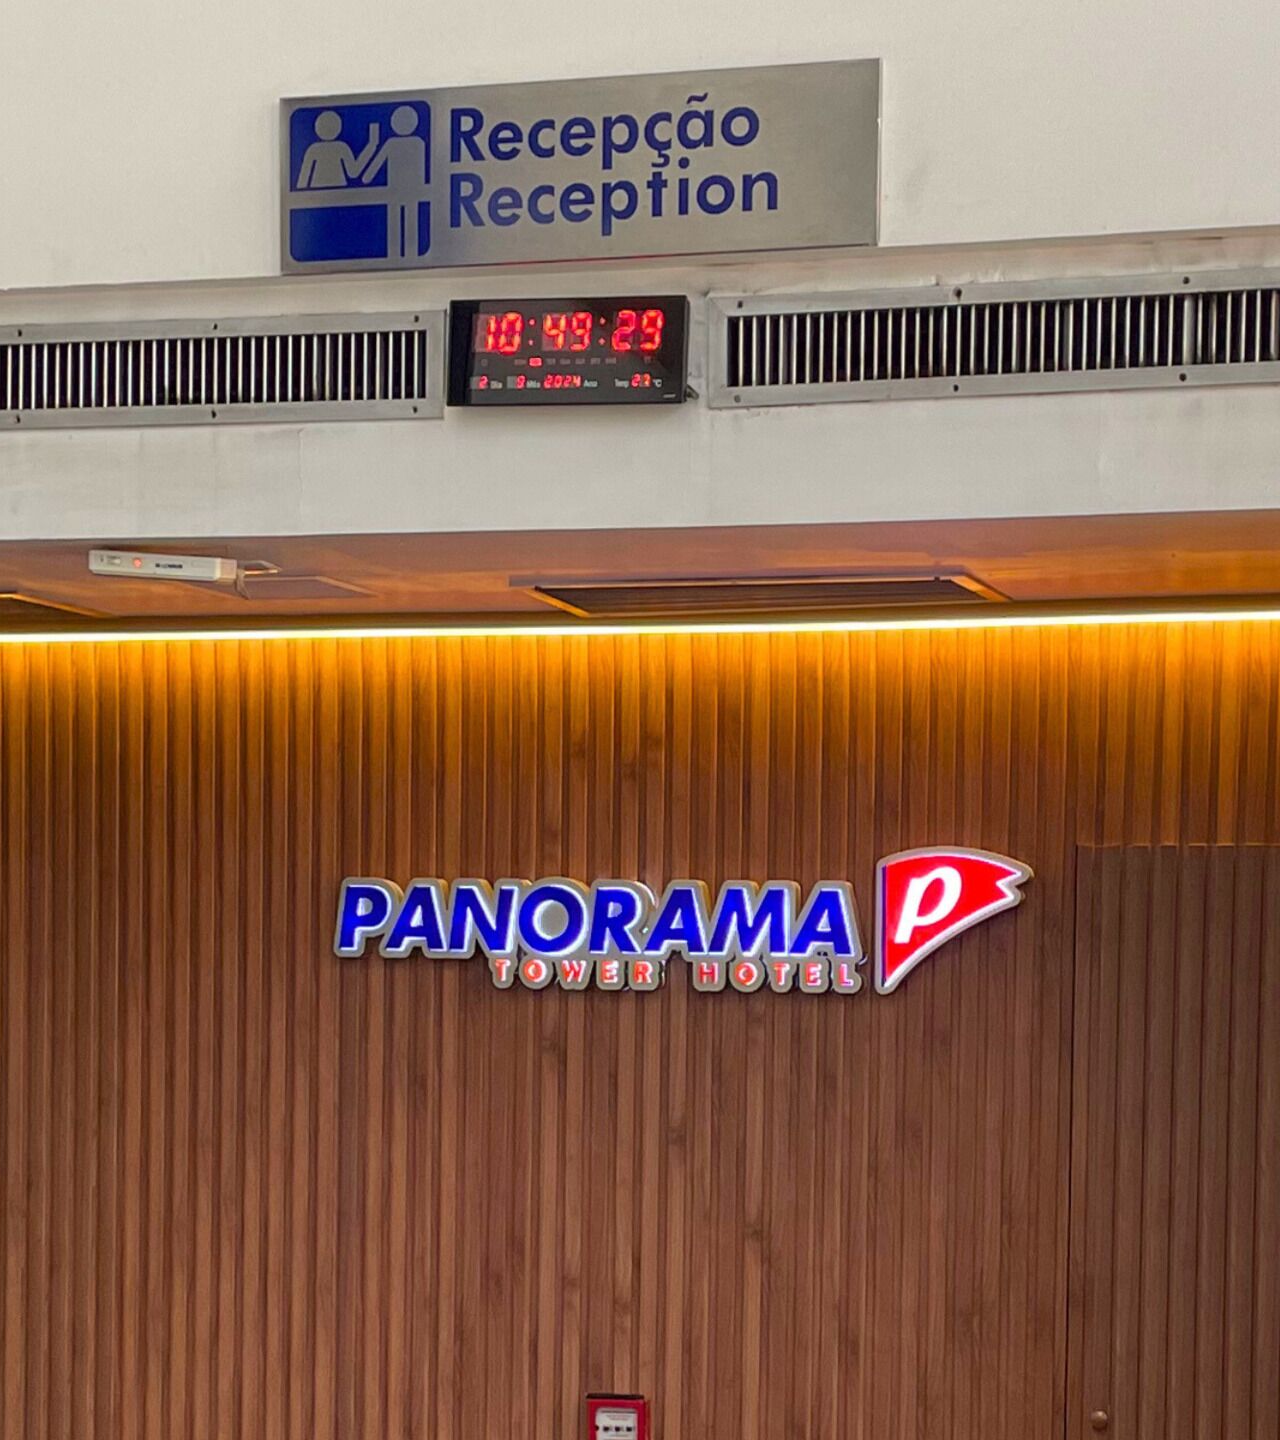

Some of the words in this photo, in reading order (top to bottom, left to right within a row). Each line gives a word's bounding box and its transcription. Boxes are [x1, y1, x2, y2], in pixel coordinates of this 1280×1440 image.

[450, 93, 760, 170] Recepção
[450, 157, 779, 236] Reception
[543, 374, 581, 389] 2024
[337, 882, 859, 957] PANORAMA
[493, 957, 654, 985] TOWER
[697, 957, 855, 987] HOTEL
